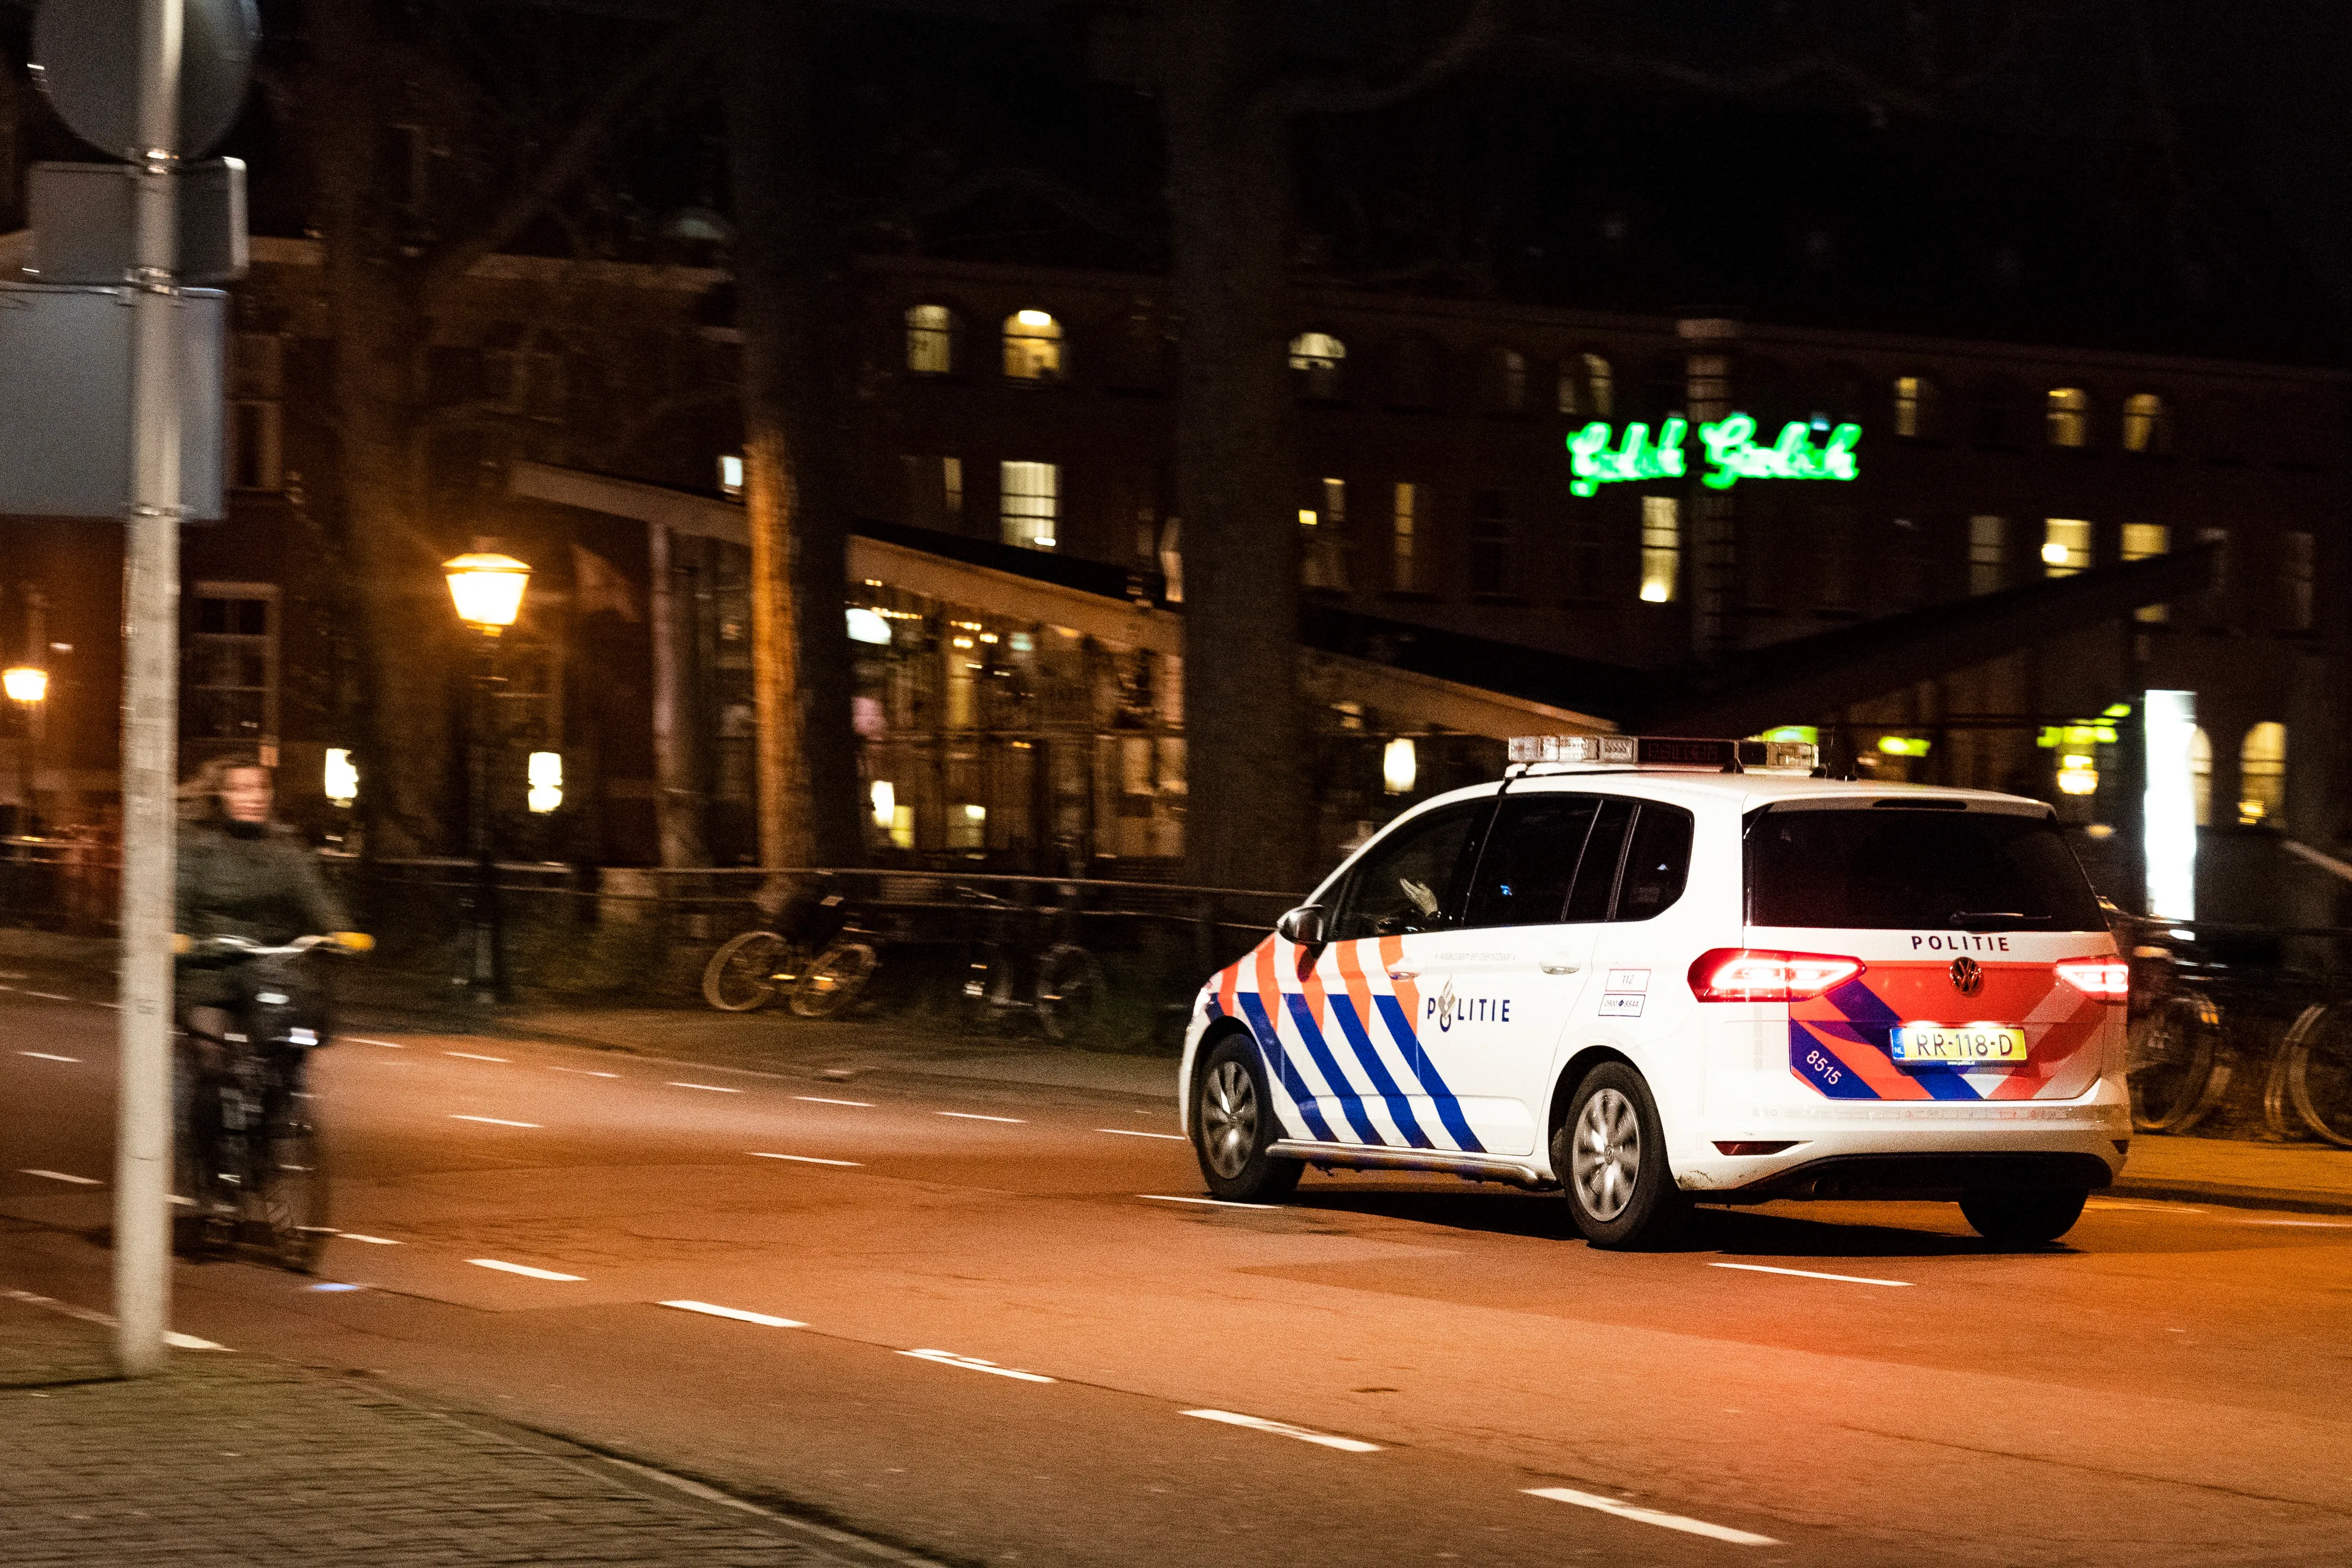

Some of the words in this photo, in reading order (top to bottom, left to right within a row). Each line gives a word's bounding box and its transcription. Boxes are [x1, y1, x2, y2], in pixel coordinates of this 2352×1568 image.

[1912, 936, 2009, 951] POLITIE
[1622, 974, 1635, 984] 112
[1428, 997, 1510, 1033] POLITIE
[1916, 1033, 2013, 1057] RR-118-D
[1807, 1050, 1842, 1085] 8515
